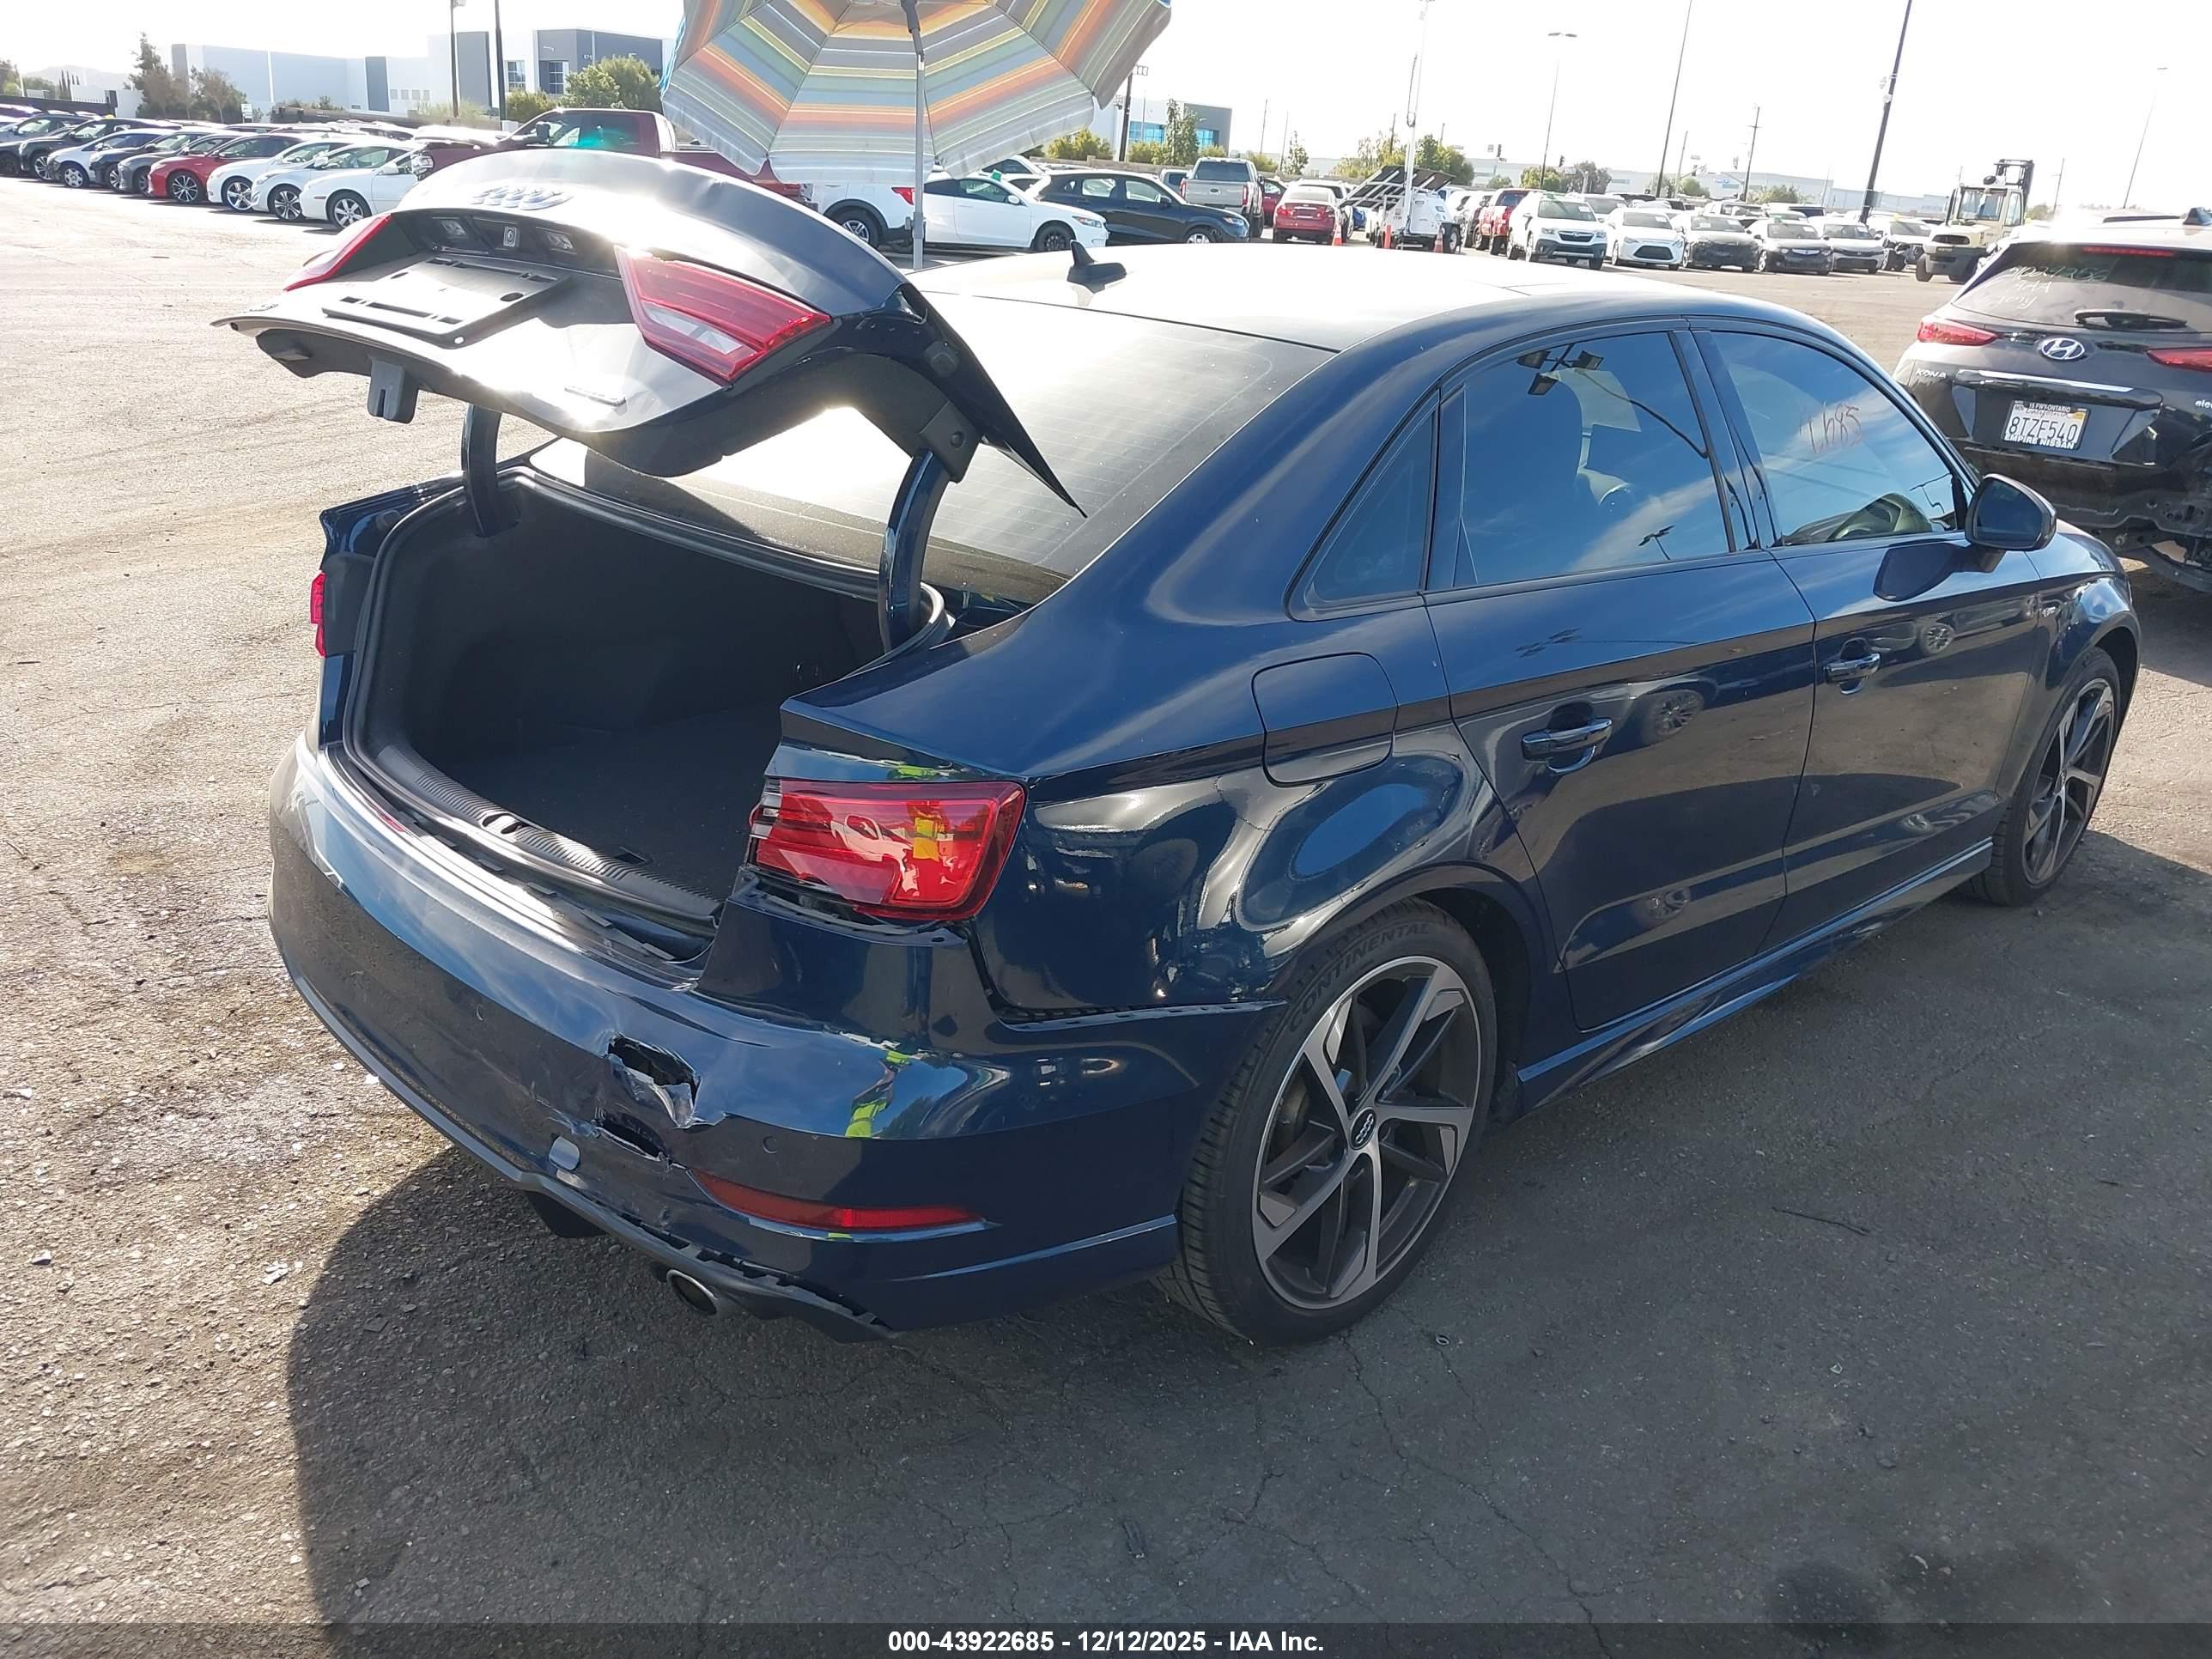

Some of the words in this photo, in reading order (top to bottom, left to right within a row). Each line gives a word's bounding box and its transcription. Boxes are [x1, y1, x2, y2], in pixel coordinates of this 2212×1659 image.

[1916, 368, 1947, 379] KONA
[2195, 399, 2212, 410] ele
[2008, 416, 2078, 442] 8TZF540
[2004, 433, 2039, 445] EMPIRE
[2039, 438, 2075, 450] NISSAN
[1290, 922, 1430, 1033] CONTINENTAL
